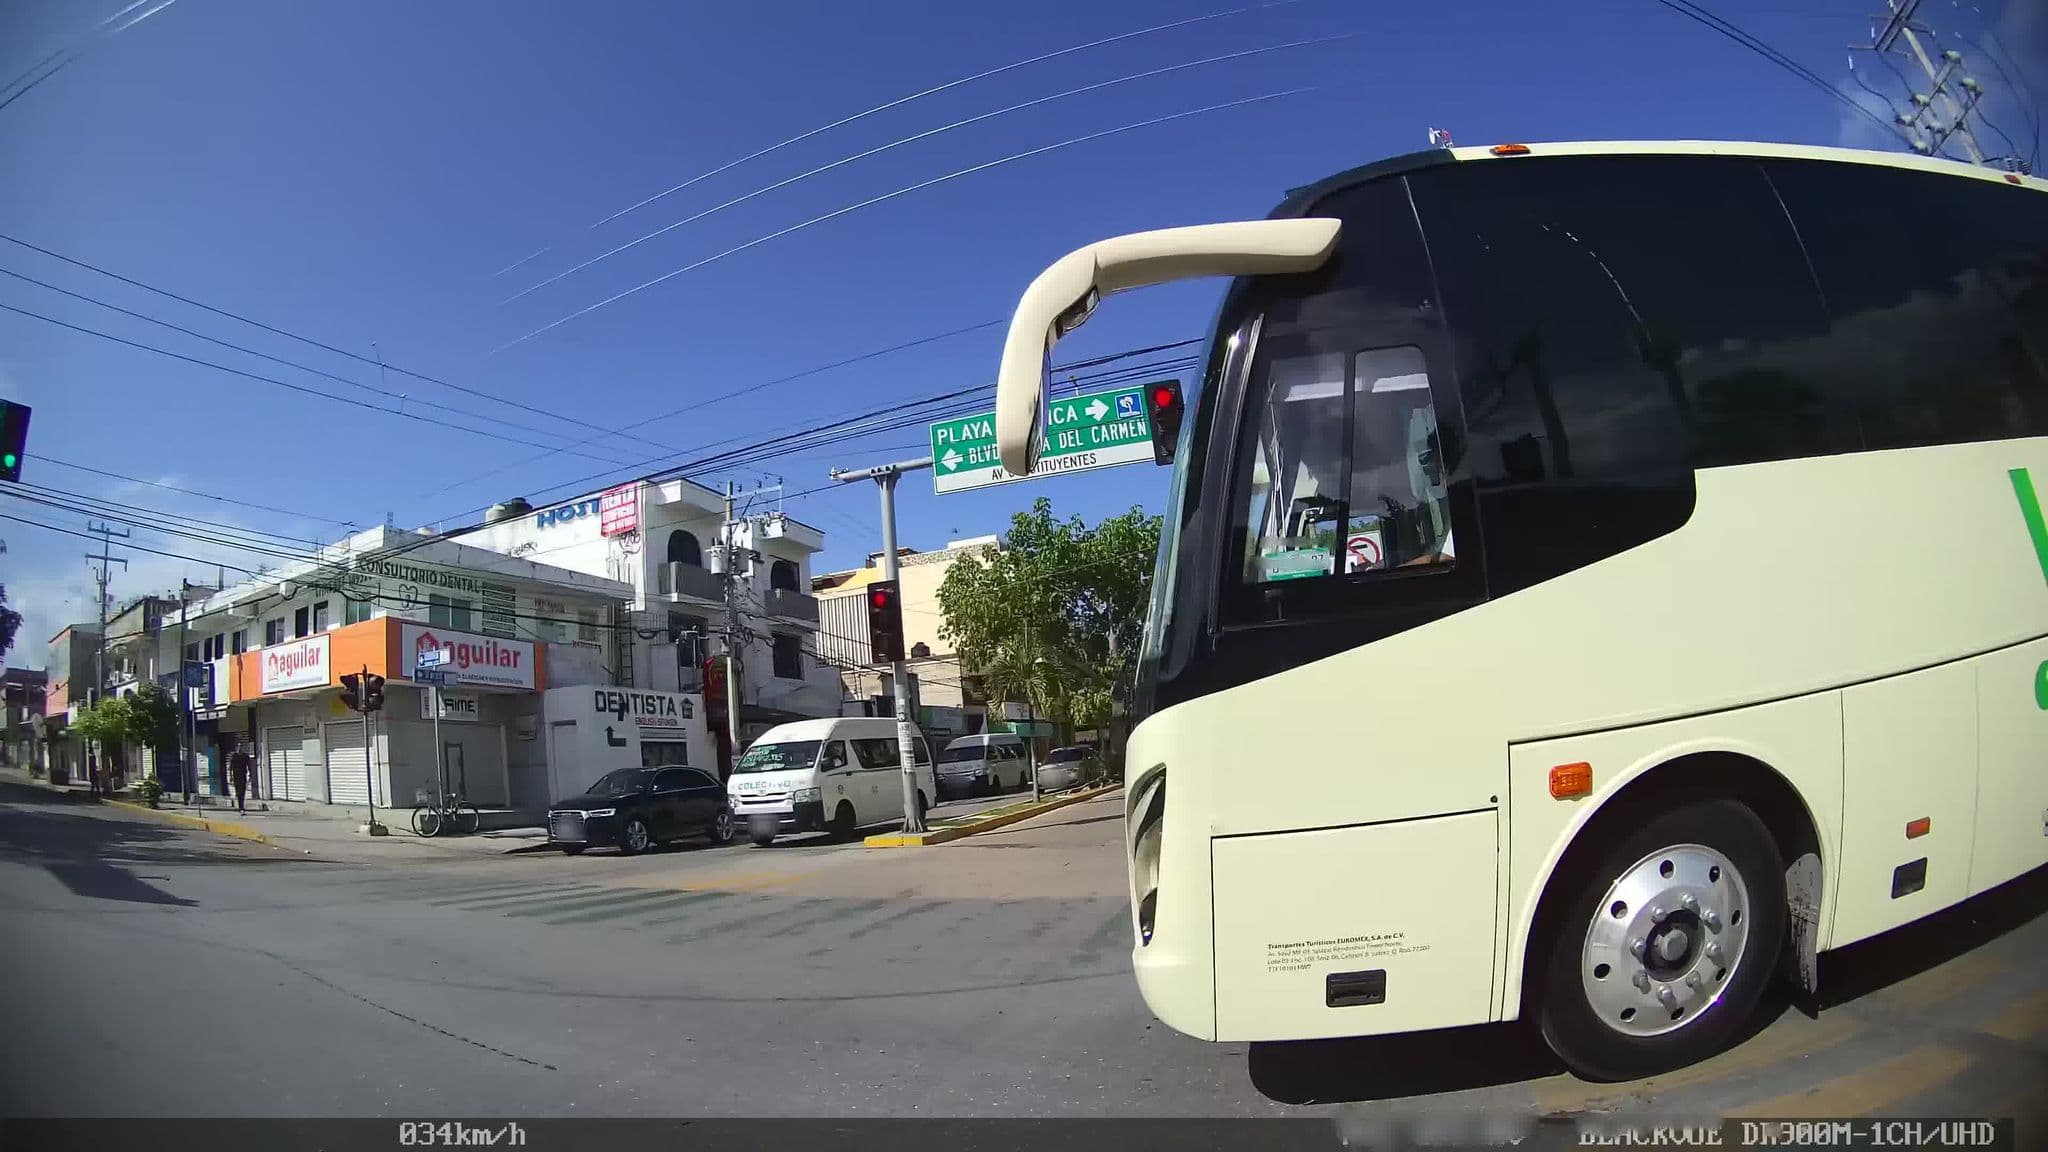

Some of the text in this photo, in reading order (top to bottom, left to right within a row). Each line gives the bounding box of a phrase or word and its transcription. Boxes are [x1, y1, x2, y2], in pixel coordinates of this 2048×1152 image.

[936, 421, 993, 446] PLAYA
[1058, 429, 1083, 449] DEL
[1091, 421, 1147, 444] CARMEN
[991, 469, 1004, 481] AV
[359, 559, 437, 585] CONSULTORIO
[440, 573, 480, 594] DENTAL
[279, 644, 321, 677] aguilar
[443, 640, 521, 669] aguilar
[594, 690, 678, 717] DENTISTA
[1268, 941, 1305, 951] Transportes
